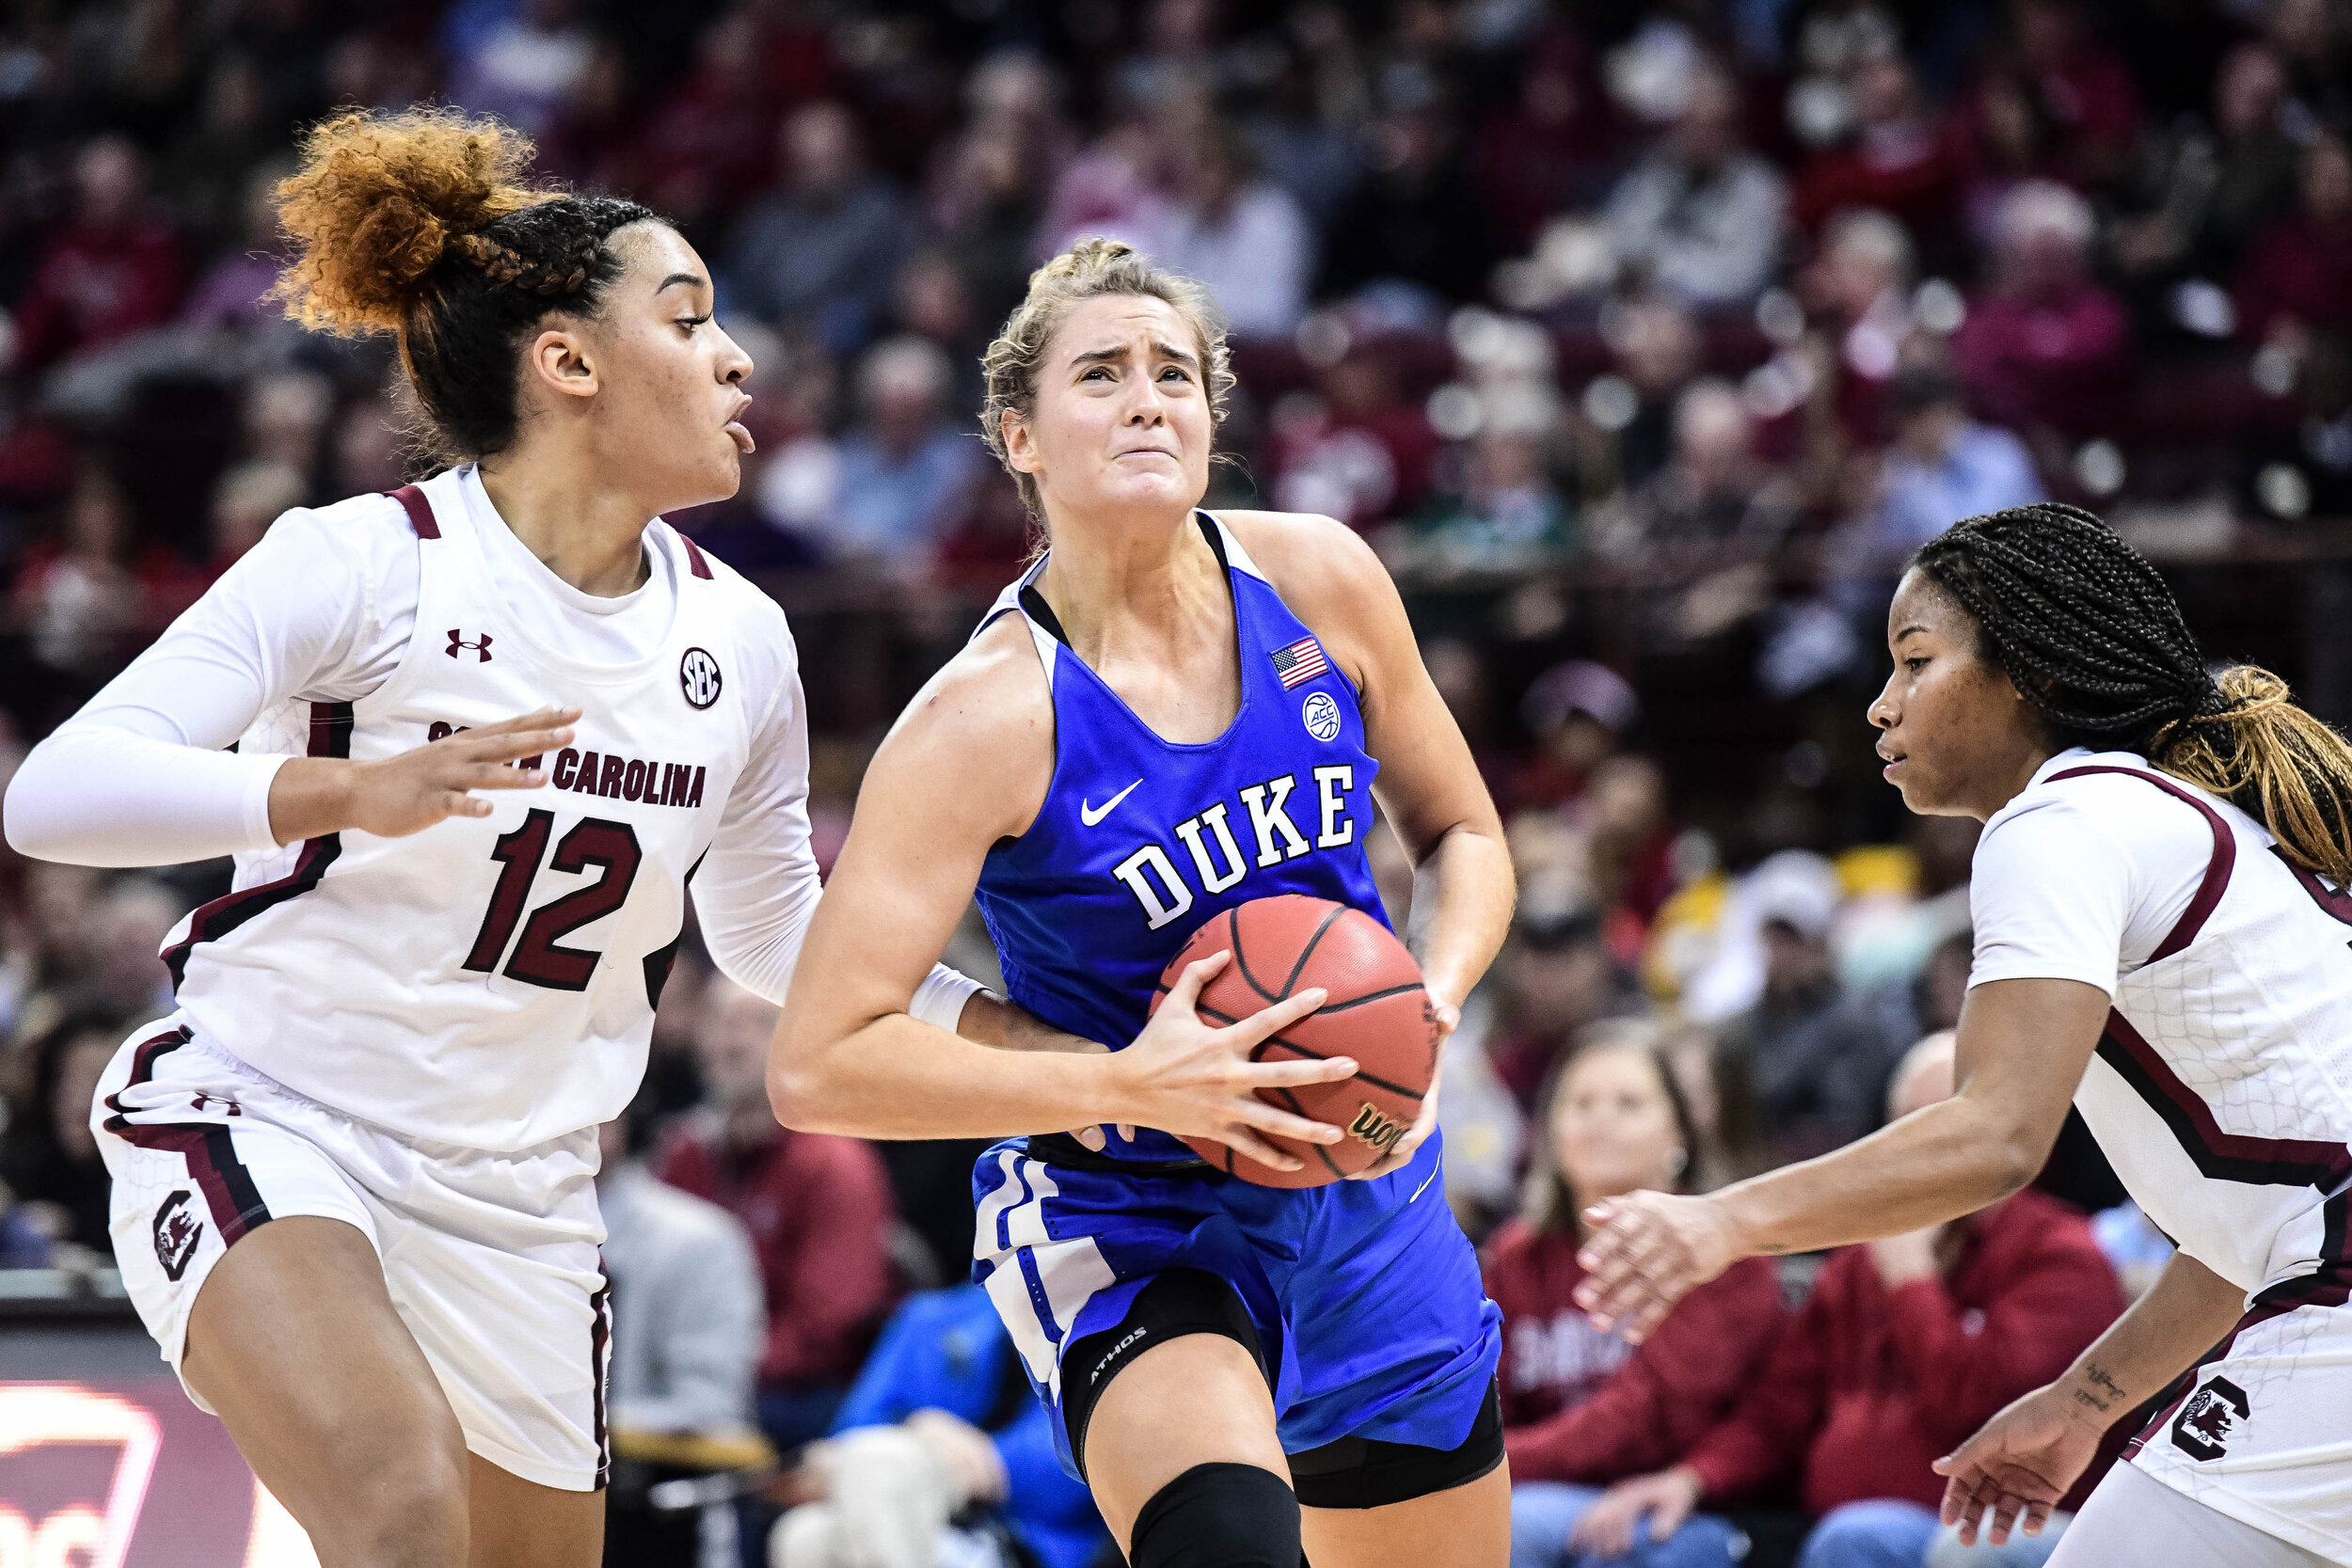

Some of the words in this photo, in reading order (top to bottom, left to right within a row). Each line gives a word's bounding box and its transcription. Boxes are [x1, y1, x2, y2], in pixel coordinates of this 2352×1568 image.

[682, 650, 720, 705] SEC
[1311, 704, 1334, 723] ACC
[552, 748, 706, 808] CAROLINA
[1110, 764, 1355, 931] DUKE
[461, 807, 643, 991] 12
[1090, 1326, 1147, 1386] ATHOS
